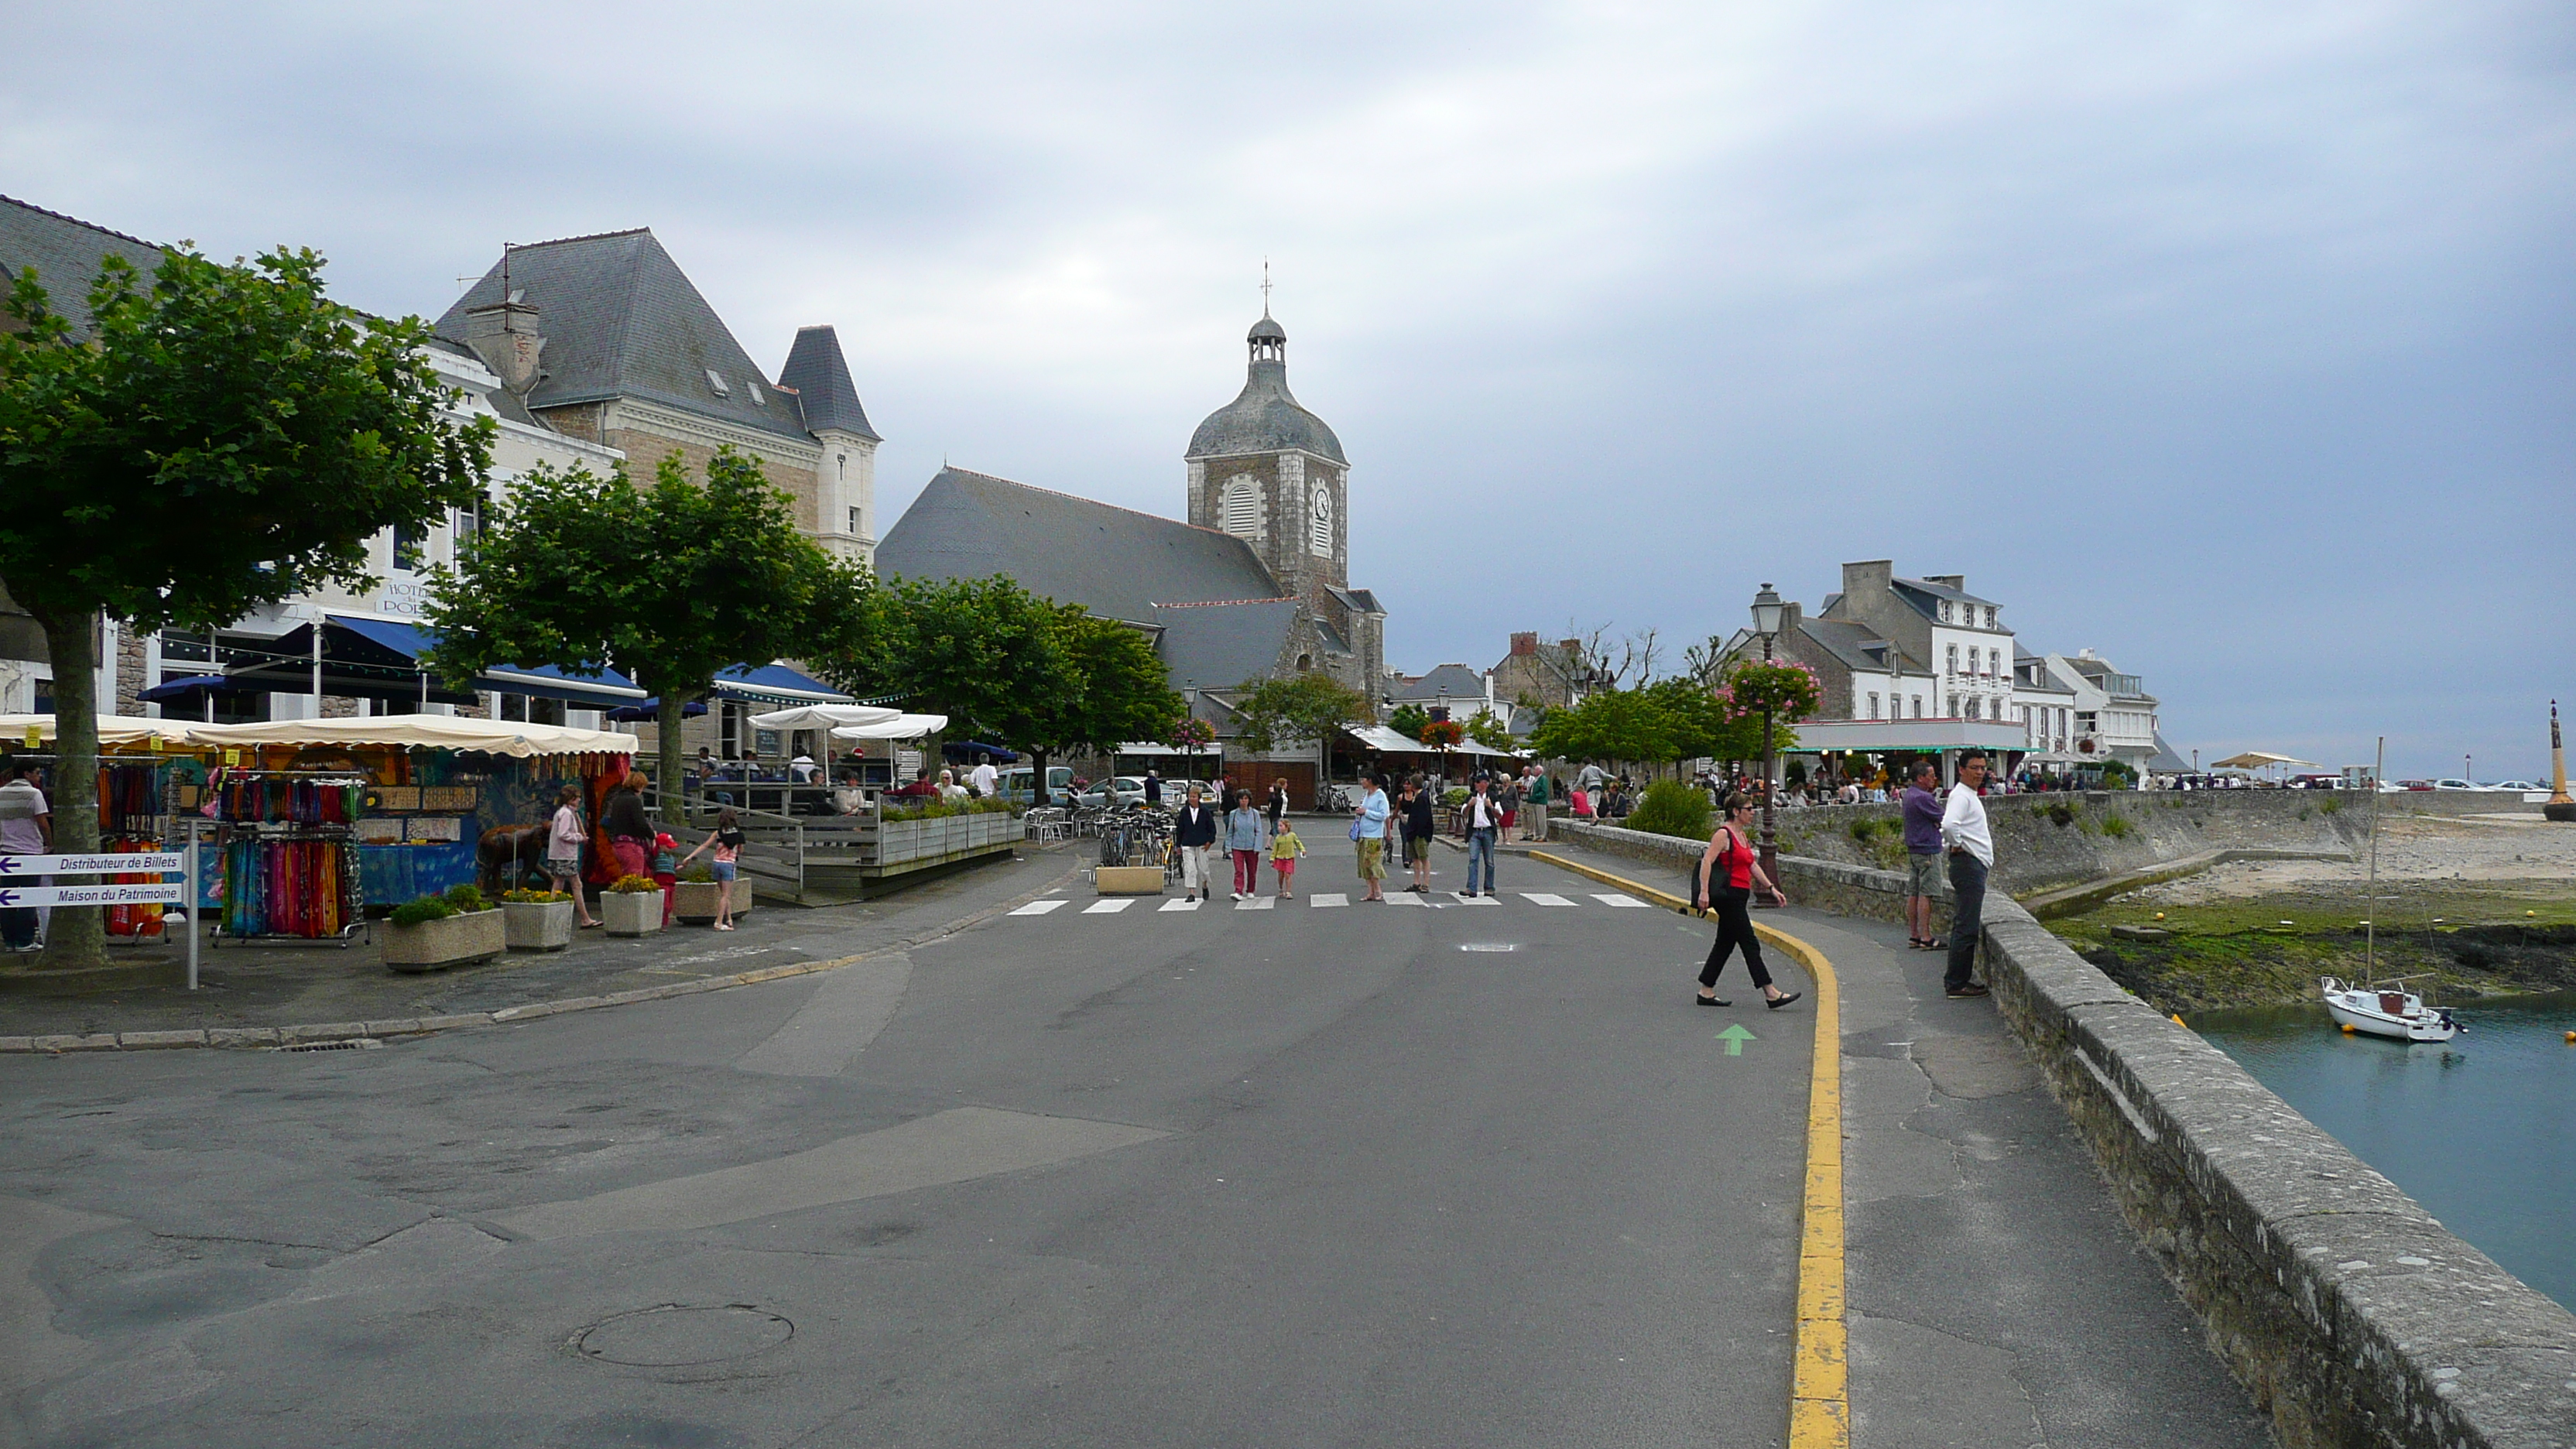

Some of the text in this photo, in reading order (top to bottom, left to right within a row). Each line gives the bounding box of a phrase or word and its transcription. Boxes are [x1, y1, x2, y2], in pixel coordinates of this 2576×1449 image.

[60, 856, 177, 869] Distributeur de Billets
[58, 888, 177, 902] Maison du Patrimoine
